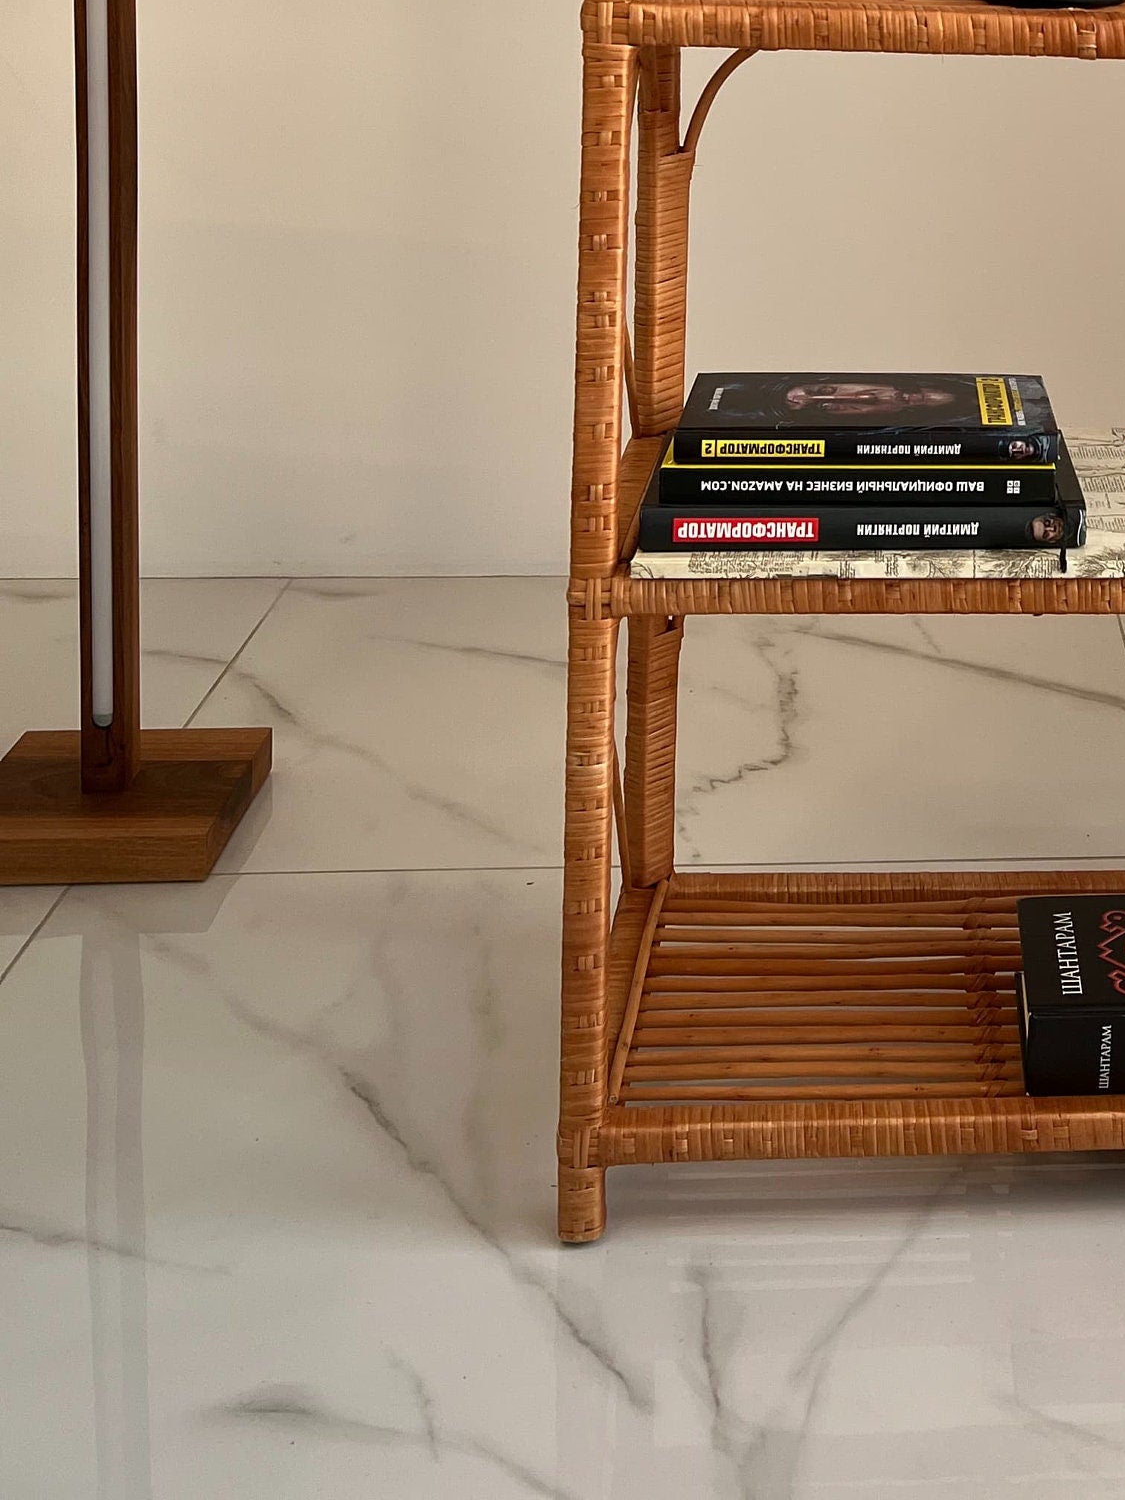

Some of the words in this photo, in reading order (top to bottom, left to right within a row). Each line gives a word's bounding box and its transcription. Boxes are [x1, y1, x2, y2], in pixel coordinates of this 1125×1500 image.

[705, 442, 713, 455] 2
[720, 443, 821, 455] ТРАНСФОРМАТОР
[856, 444, 911, 455] ПОРТНЯГИН
[913, 443, 962, 457] ДМИТРИЙ
[700, 480, 783, 491] AMAZON.COM
[786, 480, 803, 491] НА
[806, 481, 854, 492] БИЗНЕС
[856, 480, 953, 493] ОФИЦИАЛЬНЫЙ
[956, 481, 985, 492] ВАШ
[677, 521, 815, 538] ТРАНСФОРМАТОР
[856, 523, 920, 536] ПОРТНЯГИН
[923, 521, 980, 537] ДМИТРИЙ
[1052, 911, 1083, 995] ШАНТАРАМ
[1099, 1025, 1112, 1089] ШАНТАРАМ
